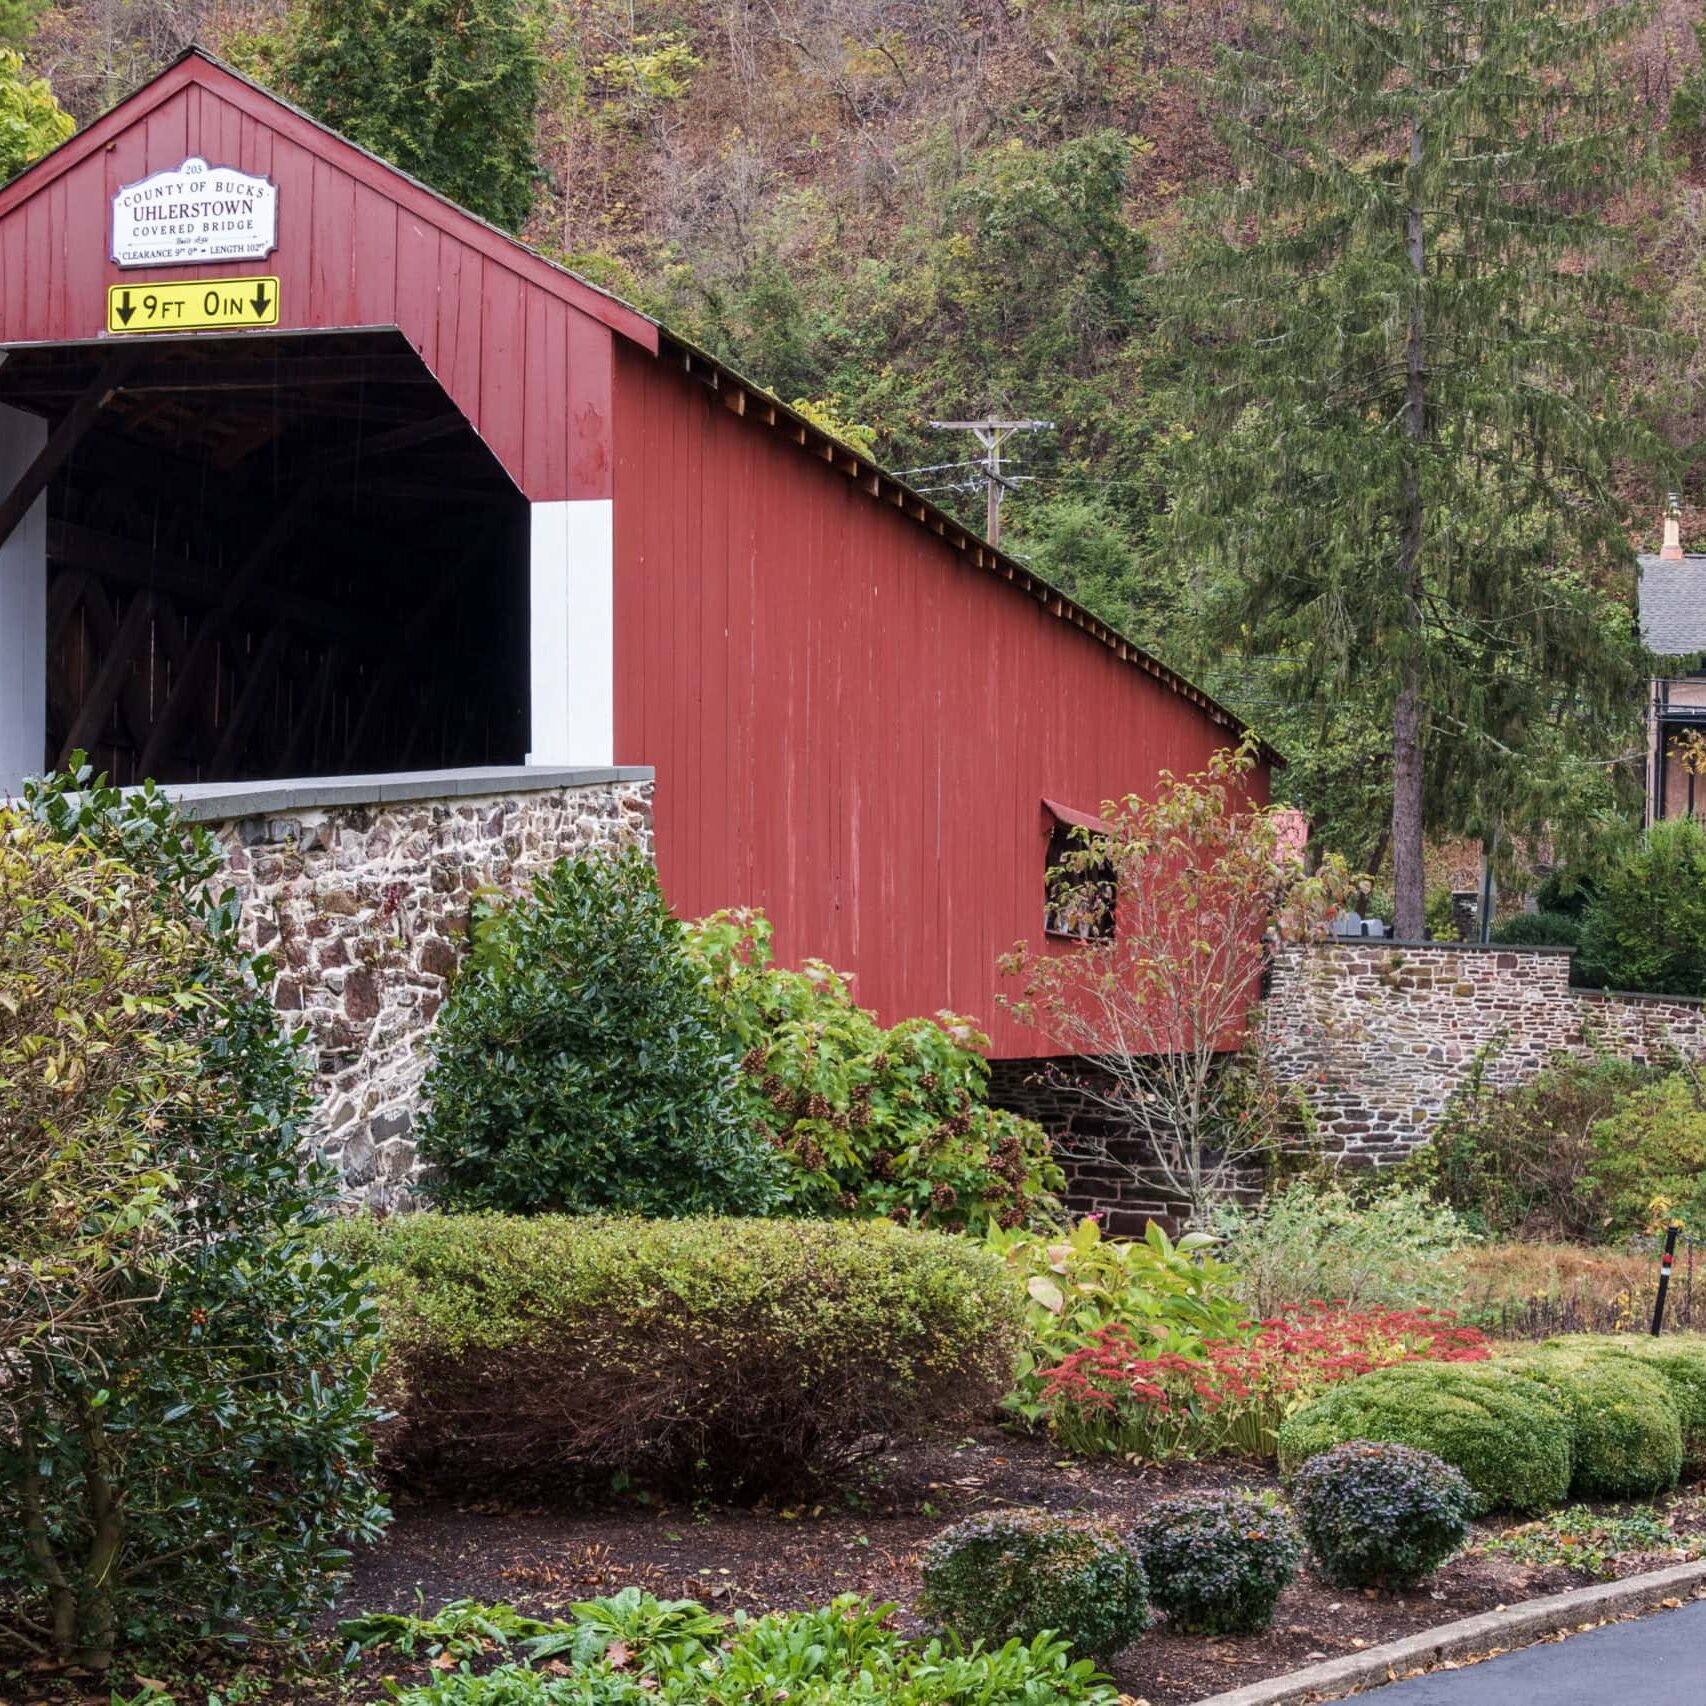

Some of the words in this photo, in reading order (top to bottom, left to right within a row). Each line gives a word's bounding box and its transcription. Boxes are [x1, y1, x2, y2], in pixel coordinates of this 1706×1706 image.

[124, 183, 184, 208] COUNTY
[190, 181, 206, 193] OF
[215, 181, 264, 199] BUCKS
[133, 200, 254, 222] UHLERSTOWN
[133, 224, 195, 237] COVERED
[203, 220, 253, 232] BRIDGE
[122, 249, 172, 260] CLEARANCE
[210, 245, 244, 255] LENGTH
